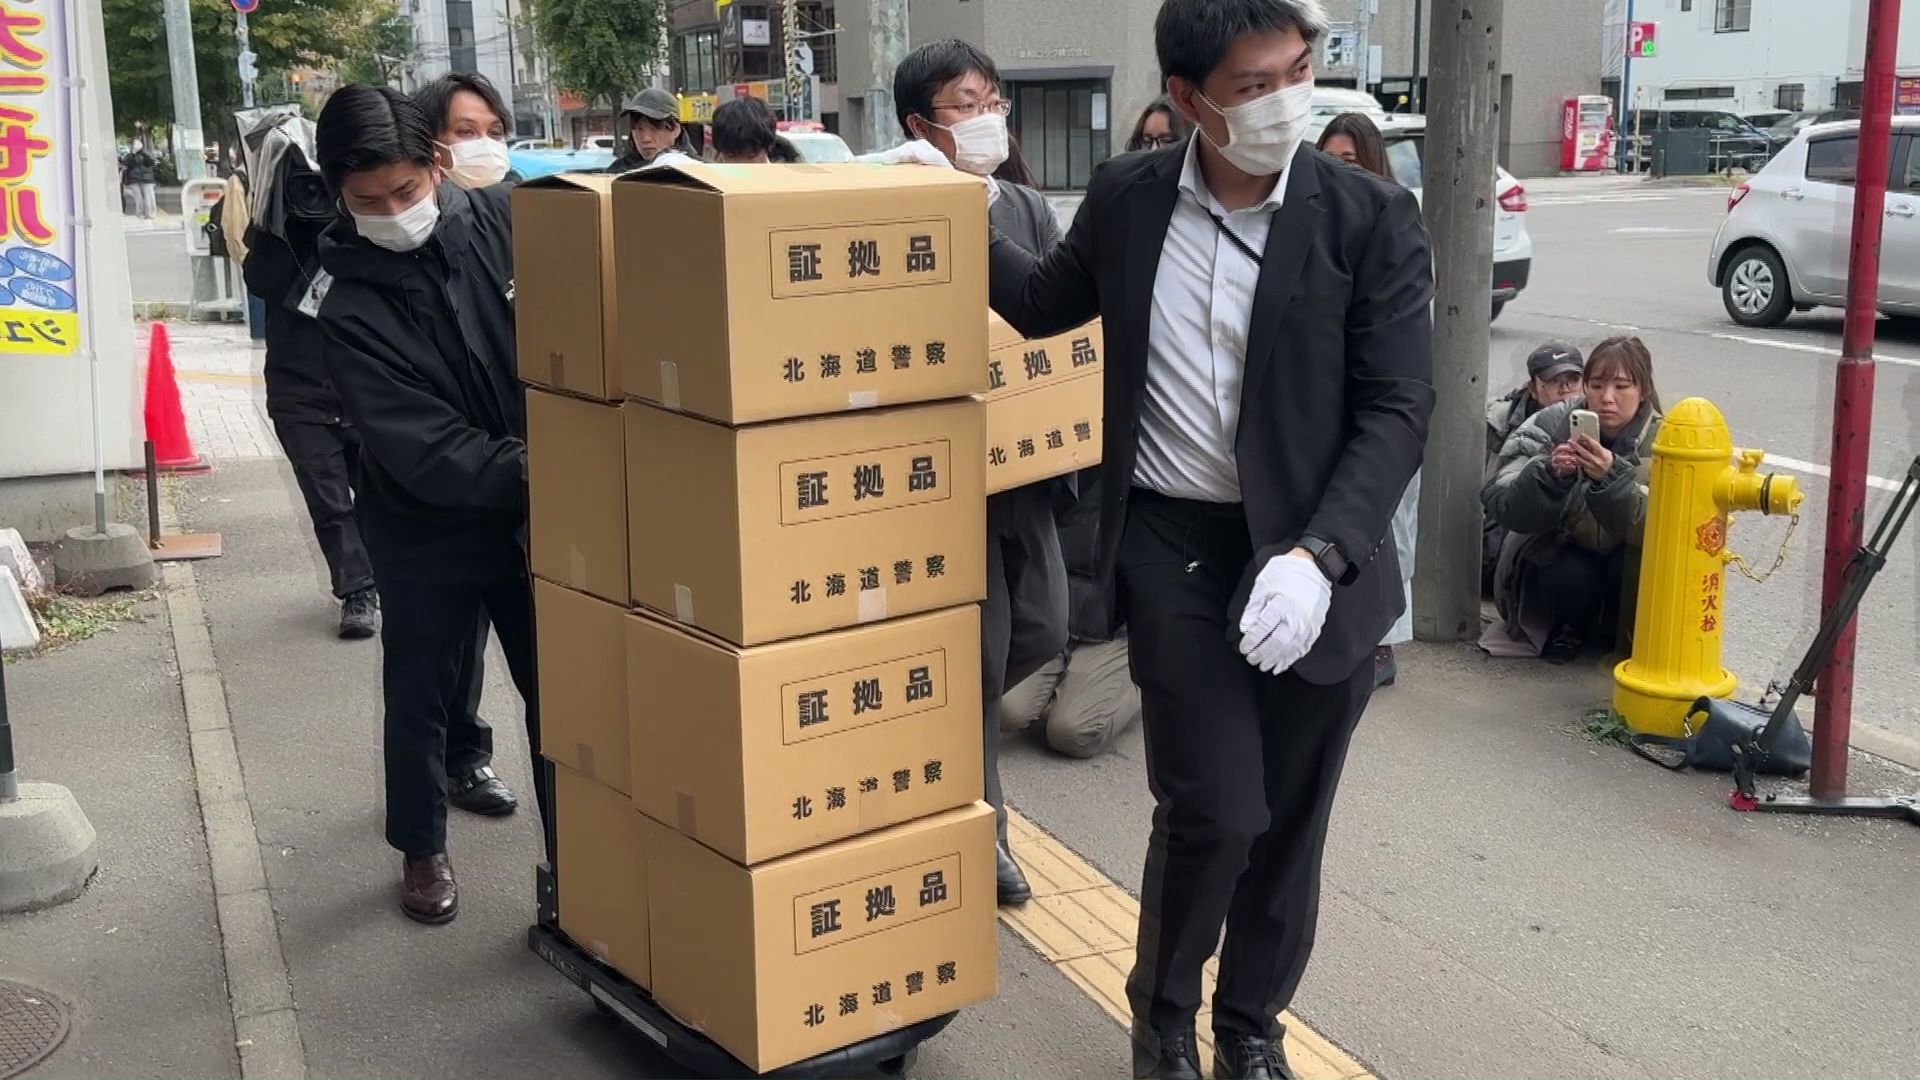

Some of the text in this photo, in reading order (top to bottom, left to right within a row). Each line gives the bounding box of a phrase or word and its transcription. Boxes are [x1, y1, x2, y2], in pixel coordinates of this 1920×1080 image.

[1630, 26, 1644, 53] P
[788, 234, 937, 284] 証拠品
[783, 341, 946, 383] 北海道警察
[987, 417, 1103, 466] 北海道警
[797, 455, 937, 511] 証拠品
[790, 554, 945, 605] 北海道警察
[1701, 573, 1719, 633] 消火栓
[797, 665, 933, 729] 証拠品
[810, 870, 948, 939] 証拠品
[803, 960, 957, 1028] 北海道警察
